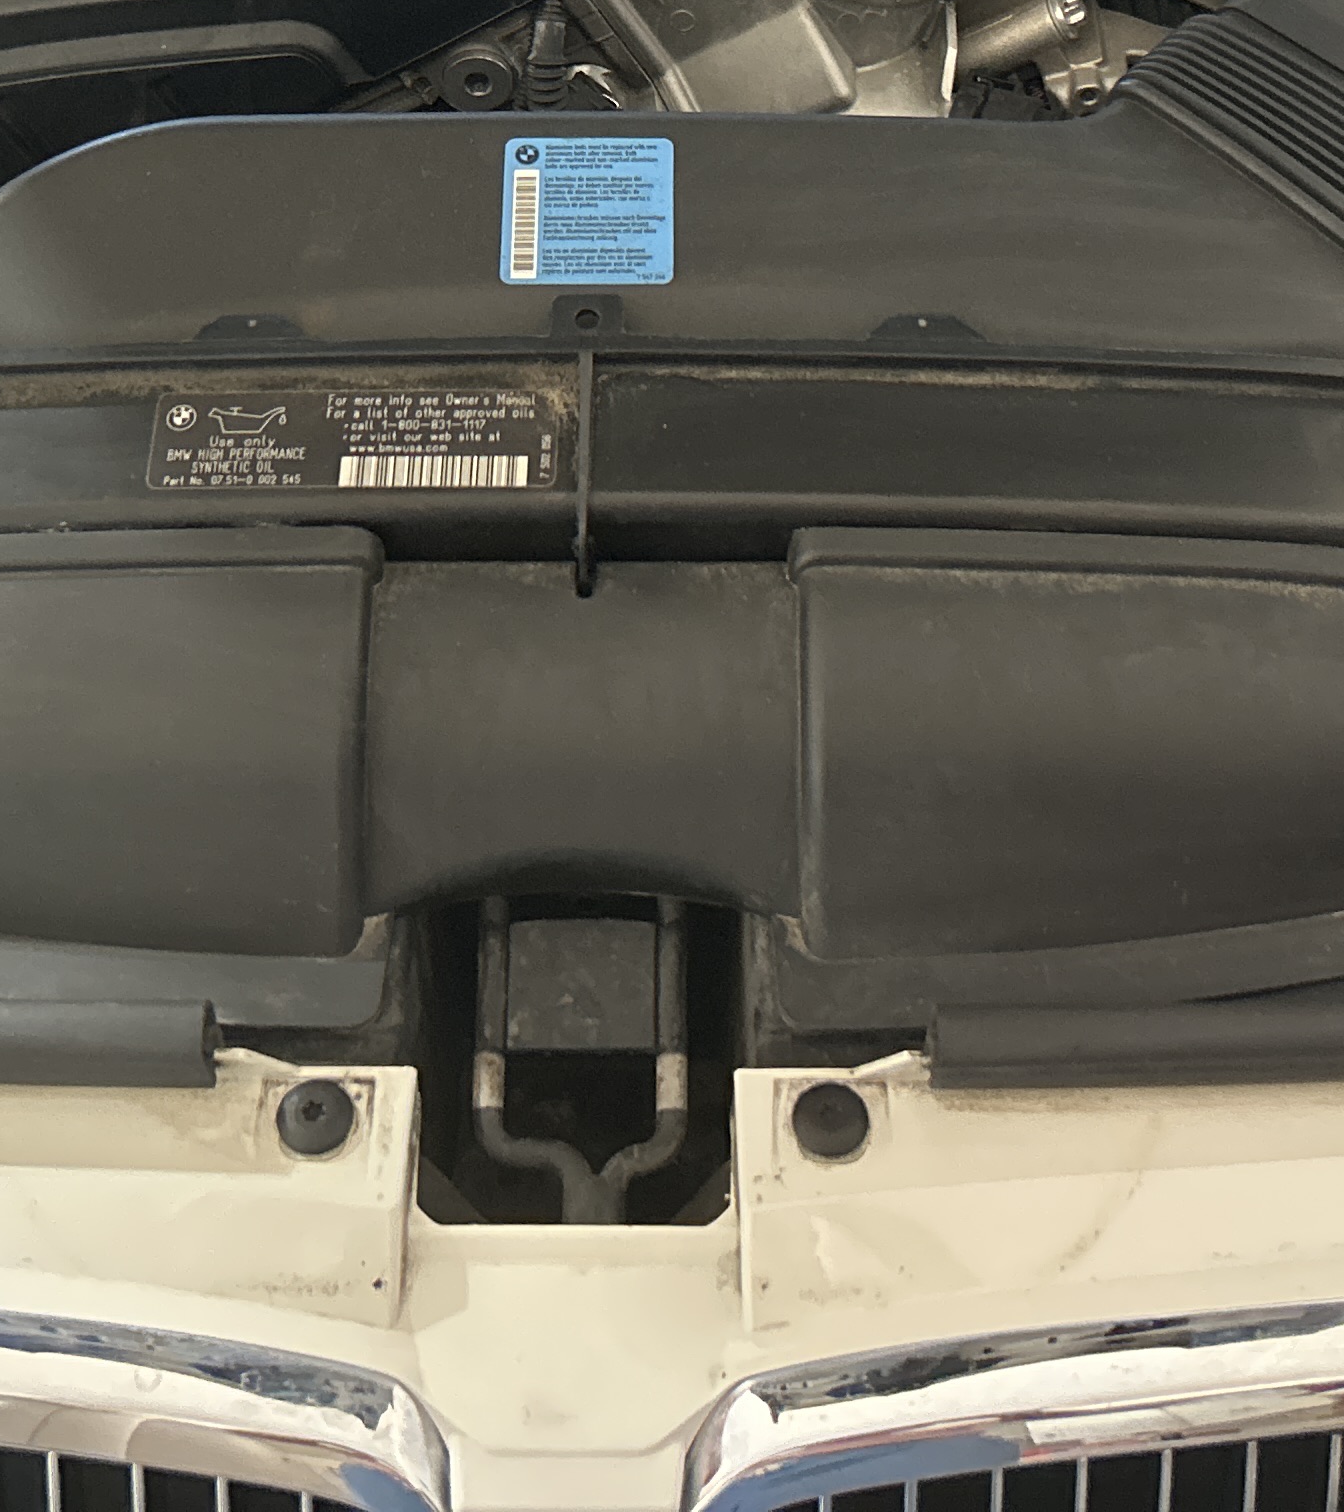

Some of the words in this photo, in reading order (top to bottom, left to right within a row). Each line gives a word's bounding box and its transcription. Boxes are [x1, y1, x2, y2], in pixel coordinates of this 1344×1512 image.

[328, 394, 347, 406] For
[354, 396, 381, 406] more
[419, 396, 439, 406] see
[446, 393, 490, 406] Owner's
[497, 393, 536, 406] Manual
[326, 407, 346, 418] For
[353, 409, 360, 418] a
[367, 406, 388, 418] list
[395, 406, 408, 418] of
[415, 406, 446, 418] other
[453, 406, 505, 421] approved
[512, 406, 535, 418] oils
[351, 420, 374, 430] call
[382, 419, 486, 430] 1-800-831-1117
[209, 435, 234, 447] Use
[244, 434, 275, 449] only
[350, 433, 362, 442] or
[370, 431, 397, 442] visit
[404, 433, 422, 442] our
[430, 431, 452, 442] web
[459, 431, 481, 442] site
[488, 431, 501, 442] at
[349, 442, 448, 453] www.bmwusa.com
[166, 448, 193, 462] BMW
[198, 448, 224, 461] HIGH
[229, 447, 306, 461] PERFORMANCE
[191, 461, 251, 474] SYNTHETIC
[256, 461, 274, 473] OIL
[163, 475, 184, 486] Part
